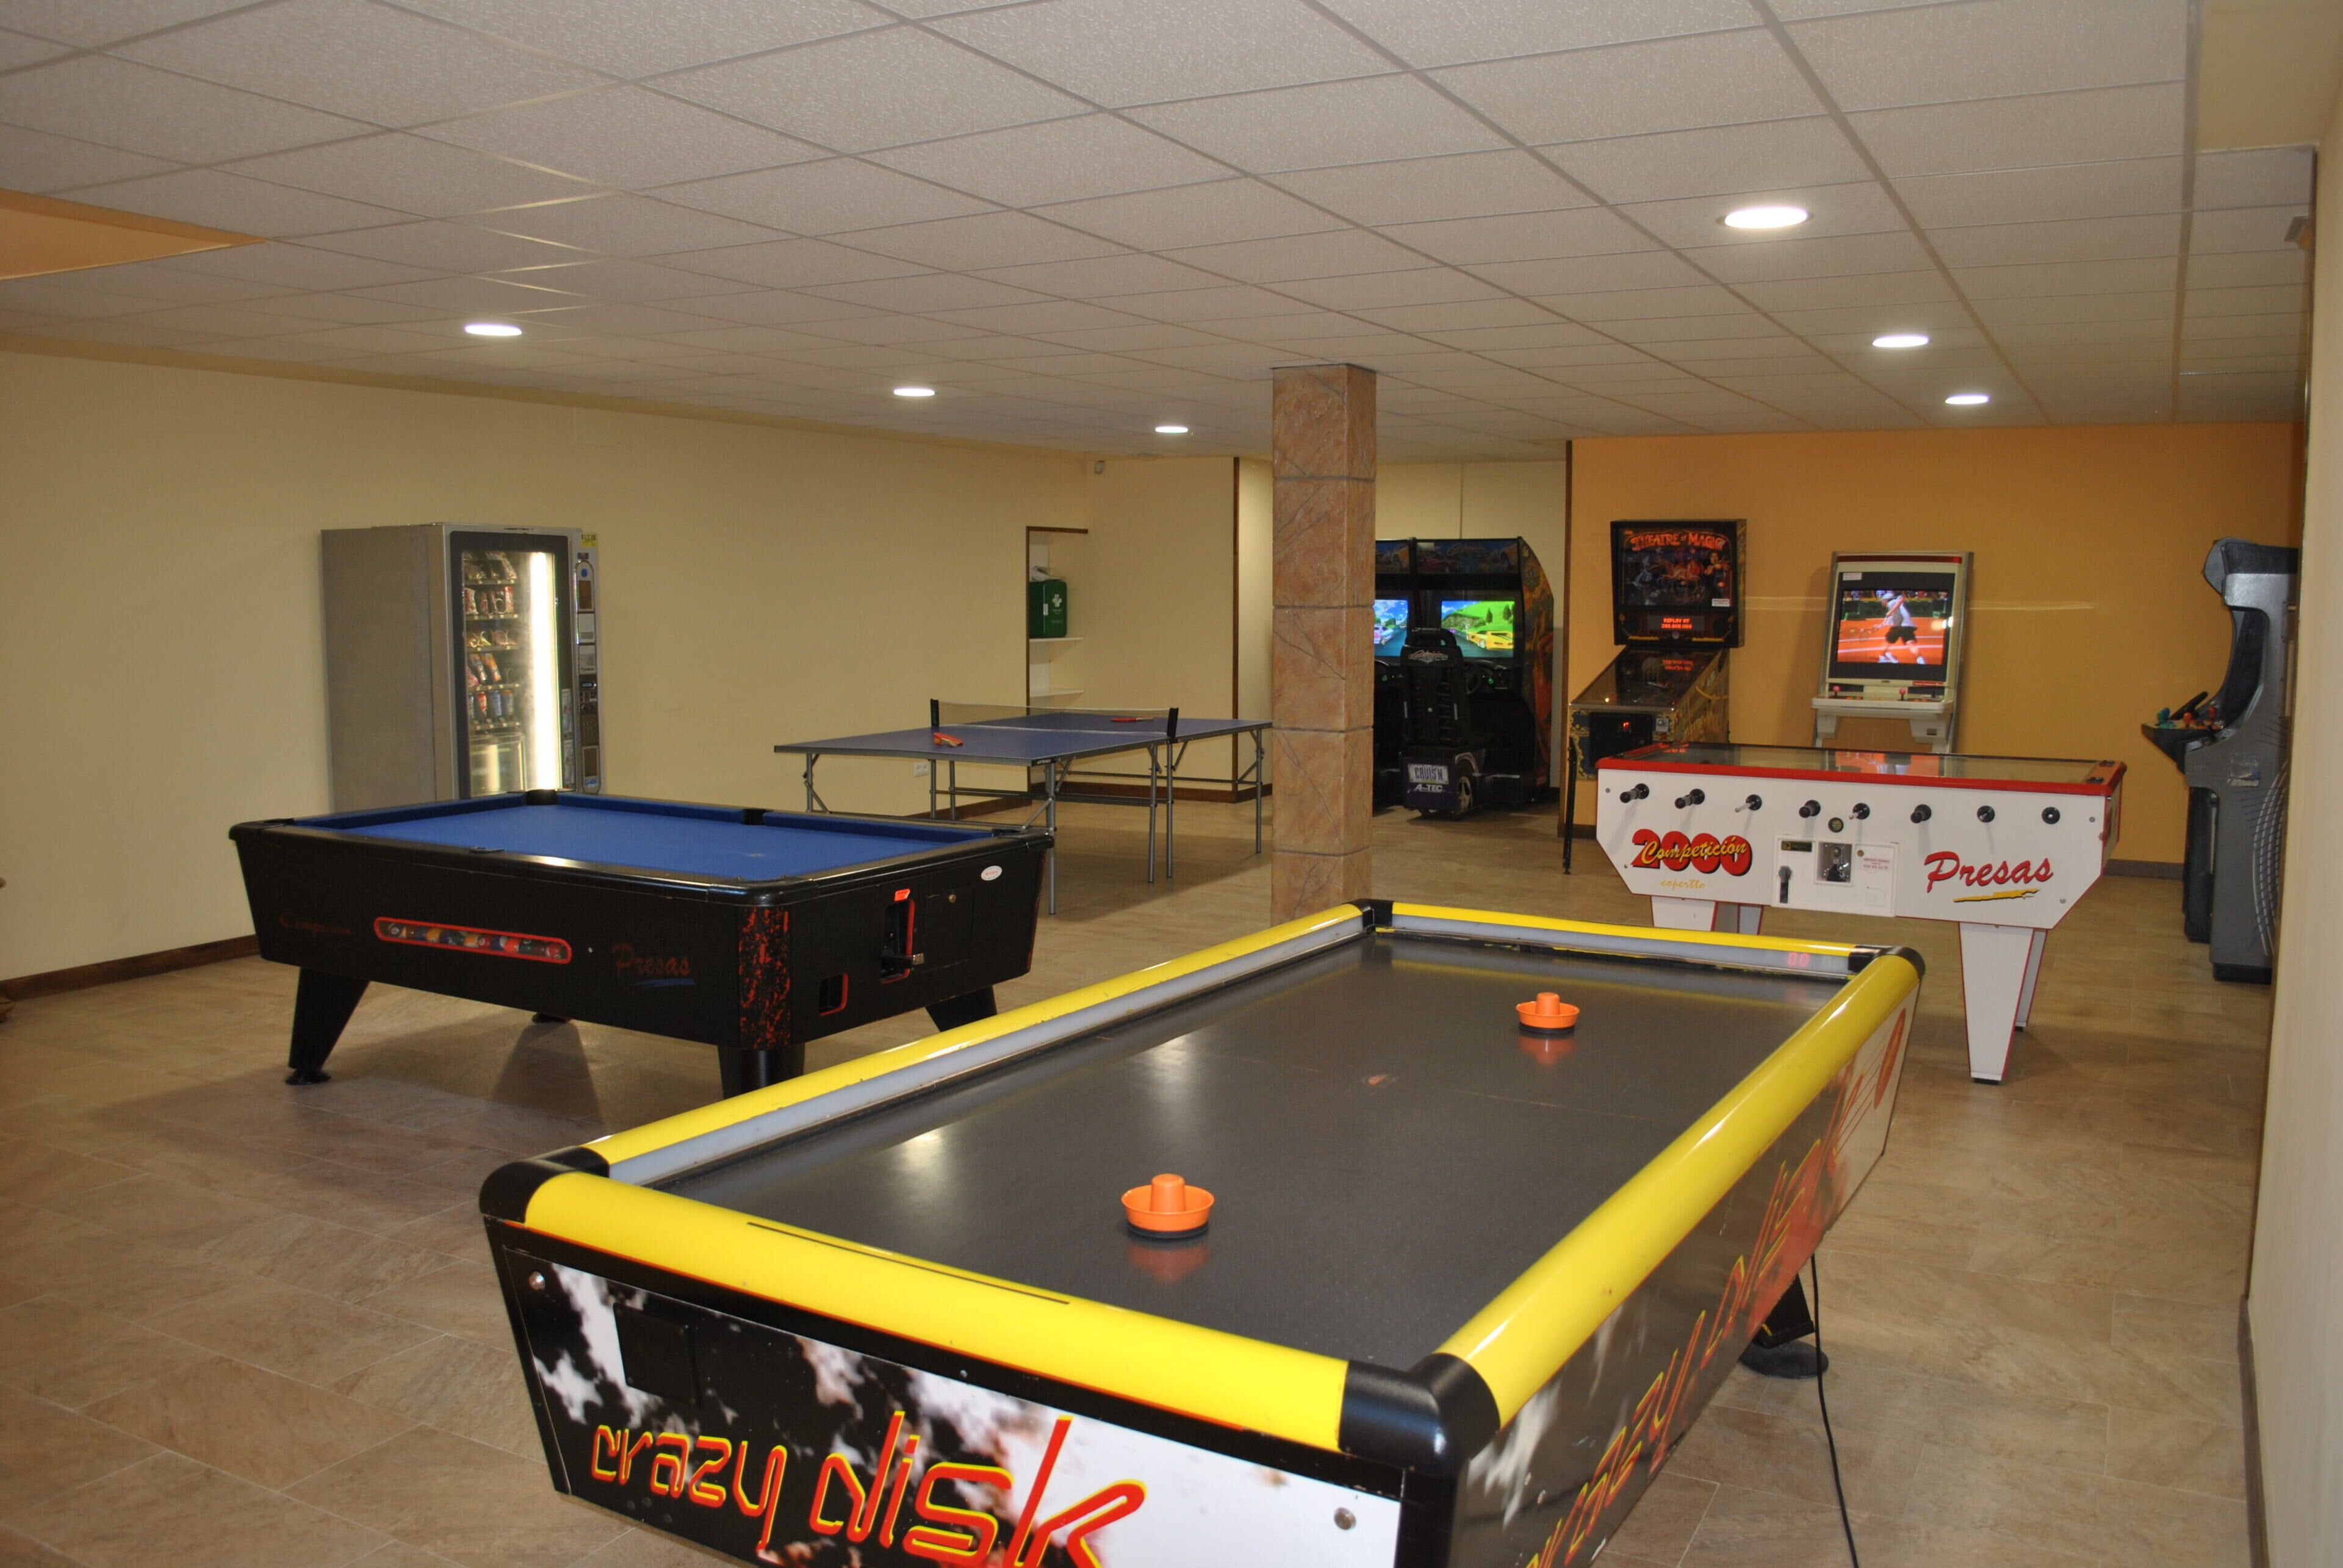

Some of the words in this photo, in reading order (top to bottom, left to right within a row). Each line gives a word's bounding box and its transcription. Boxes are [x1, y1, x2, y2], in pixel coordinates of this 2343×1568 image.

[1630, 533, 1680, 551] THEATRE
[1641, 836, 1747, 865] Competición
[1924, 851, 2054, 893] Presas
[611, 943, 692, 977] Presas
[591, 1424, 788, 1552] crazy
[809, 1410, 1147, 1568] disk
